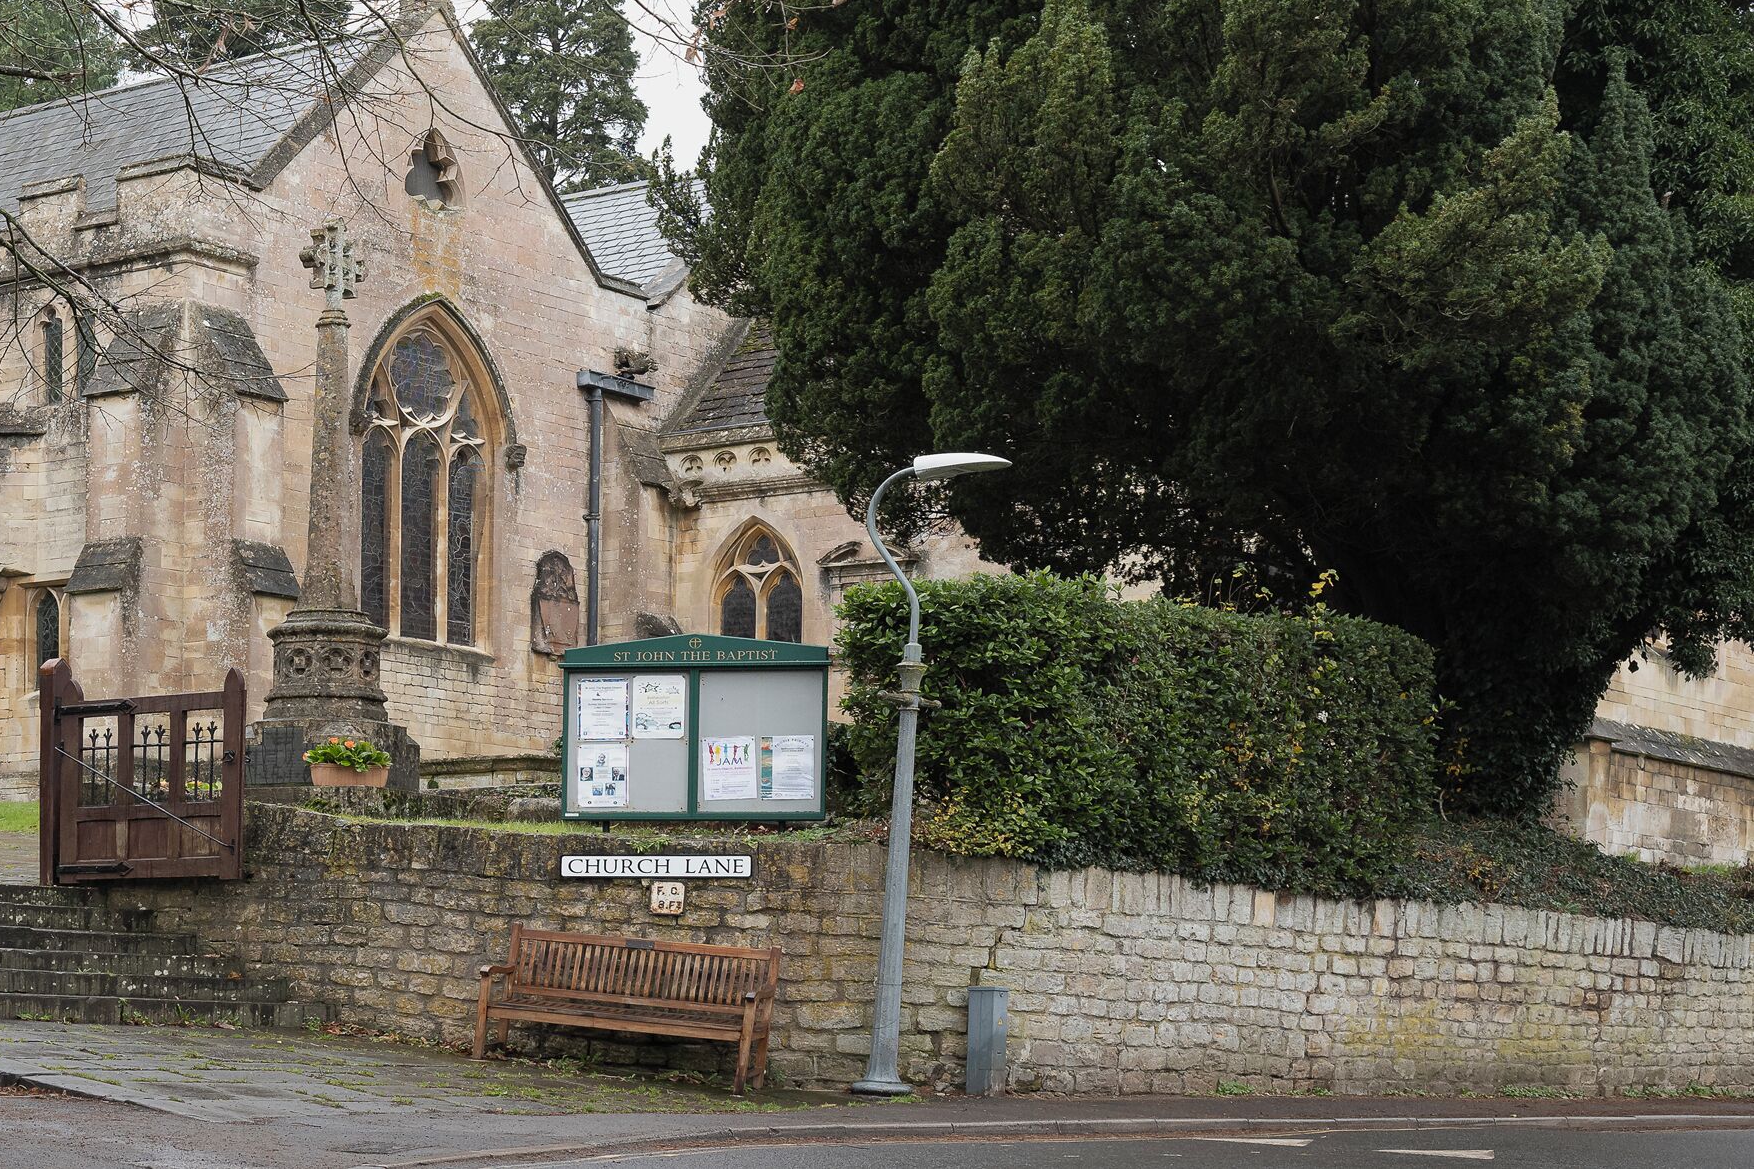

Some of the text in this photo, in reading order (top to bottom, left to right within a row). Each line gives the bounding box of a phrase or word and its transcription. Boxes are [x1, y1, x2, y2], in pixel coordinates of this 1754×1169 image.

[613, 649, 778, 662] ST JOHN THE BAPTIST
[716, 757, 743, 766] JAM
[567, 858, 744, 874] CHURCH LANE
